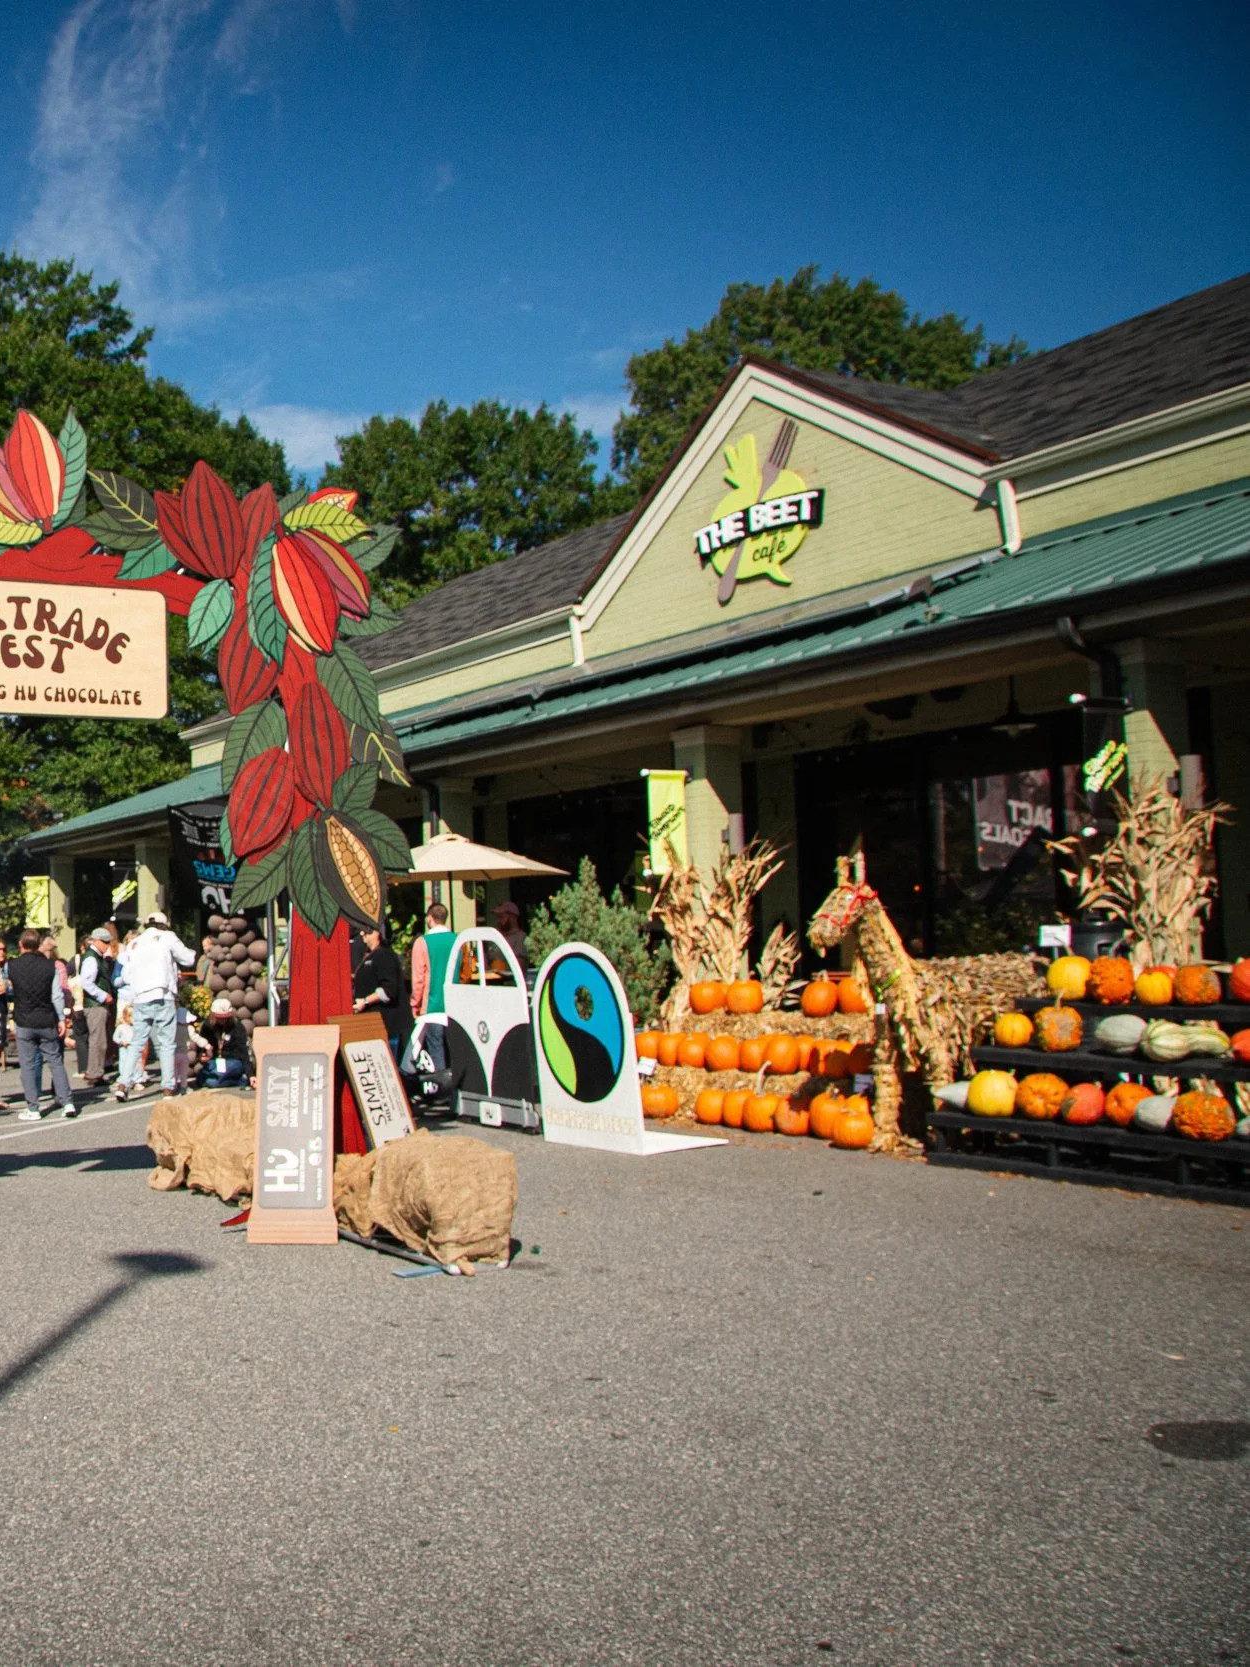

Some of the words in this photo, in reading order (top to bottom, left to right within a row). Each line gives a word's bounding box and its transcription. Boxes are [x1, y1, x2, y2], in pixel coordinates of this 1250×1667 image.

[693, 511, 746, 554] THE
[749, 490, 819, 533] BEET
[752, 535, 787, 563] café
[14, 685, 37, 701] HU
[44, 686, 142, 706] CHOCOLATE
[266, 1066, 290, 1128] SALTY
[290, 1066, 300, 1107] CHOCOLATE
[351, 1051, 387, 1126] SIMPLE
[367, 1054, 385, 1099] CHOCOLATE
[382, 1101, 392, 1122] MILK
